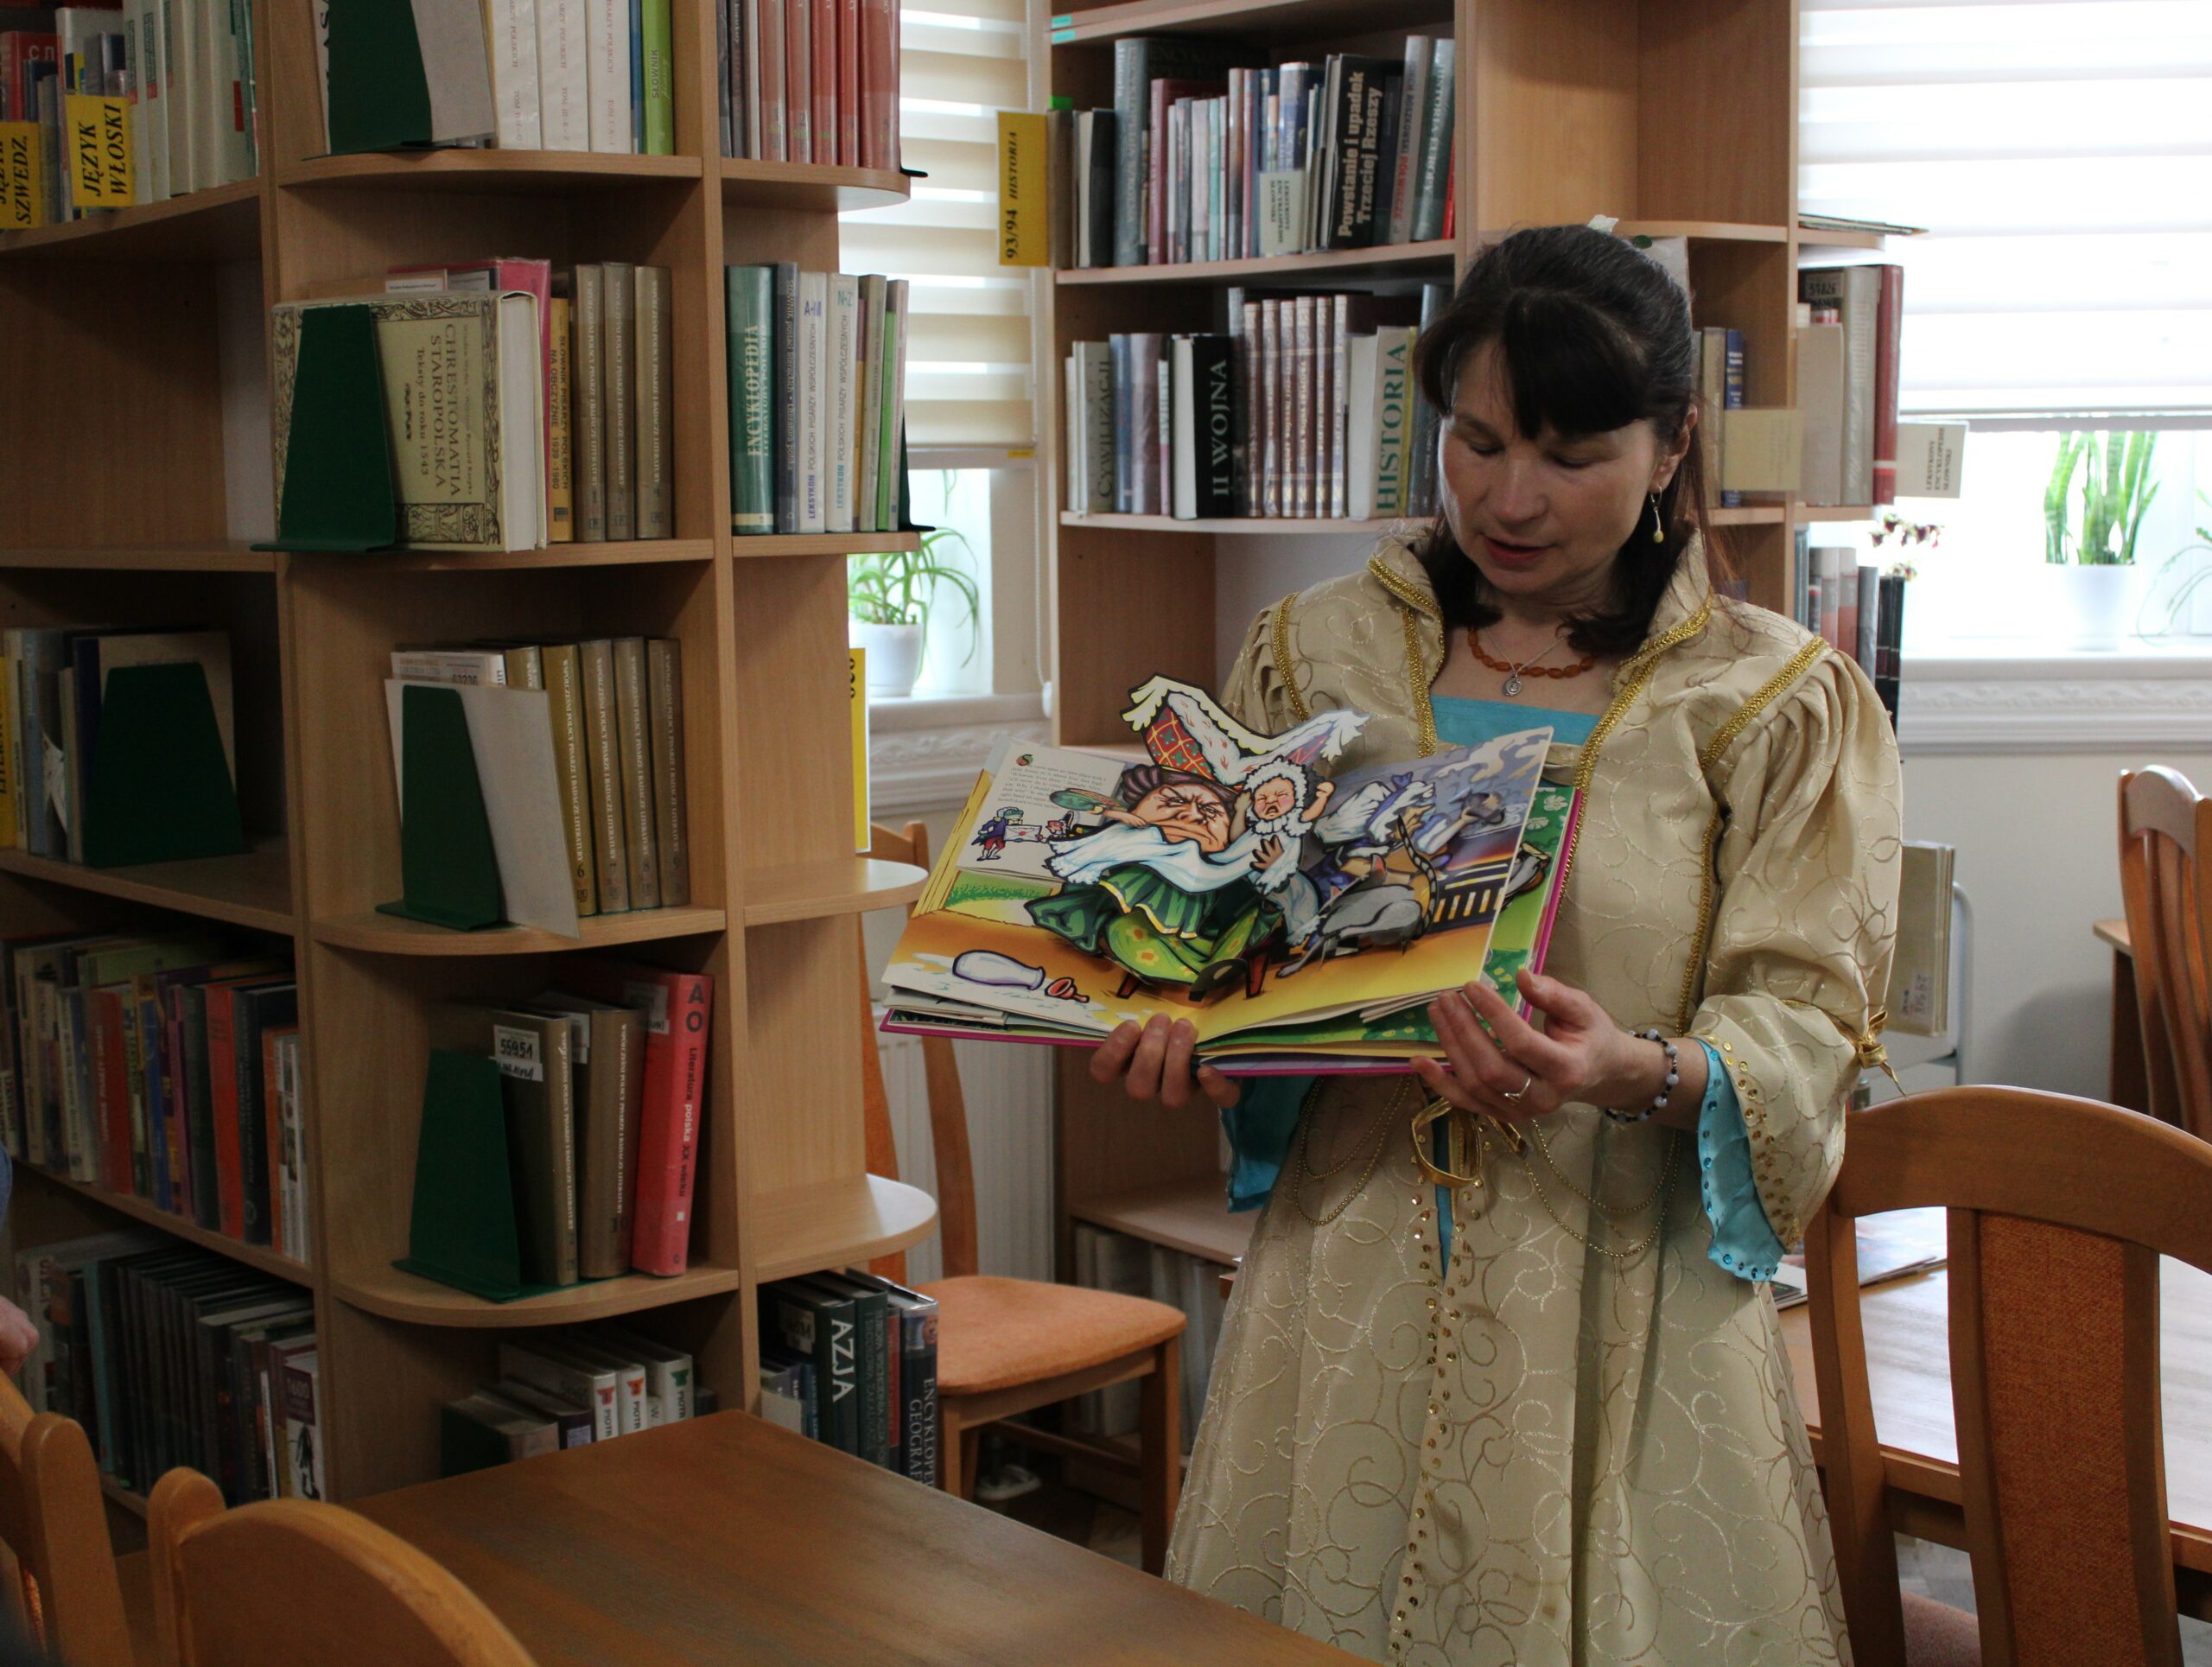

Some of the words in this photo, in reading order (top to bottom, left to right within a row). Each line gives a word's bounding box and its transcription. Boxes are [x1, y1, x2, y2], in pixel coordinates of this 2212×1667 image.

[650, 48, 660, 99] SŁOWNIK
[1347, 71, 1365, 137] upadek
[1362, 85, 1384, 152] Rzeszy
[1431, 66, 1446, 134] HISTORIA
[79, 123, 102, 198] JĘZYK
[104, 102, 129, 196] WŁOSKI
[1344, 136, 1360, 144] i
[11, 135, 31, 225] SZWEDZ.
[1008, 130, 1019, 200] HISTORIA
[1423, 137, 1440, 193] EUROPY
[1338, 148, 1359, 238] Powstanie
[1357, 151, 1380, 225] Trzeciej
[1005, 208, 1018, 259] 93/94
[786, 279, 795, 319] SŁOWNIK
[550, 349, 558, 366] NA
[785, 321, 795, 351] postaci
[416, 347, 426, 387] Teksty
[560, 335, 569, 384] SŁOWNIK
[786, 352, 795, 393] literackich
[418, 391, 427, 407] do
[430, 334, 447, 488] STAROPOLSKA
[444, 323, 461, 497] CHRESTOMATIA
[560, 387, 569, 433] PISARZY
[745, 324, 762, 456] ENCYKLOPEDIA
[839, 386, 848, 419] PISARZY
[419, 410, 428, 440] roku
[760, 385, 769, 457] LITERATURY
[786, 404, 795, 442] Literatura
[1097, 359, 1113, 499] CYWILIZACJI
[1210, 359, 1230, 468] WOJNA
[1376, 343, 1407, 511] HISTORIA
[420, 444, 429, 476] 1543
[551, 436, 560, 460] 1939
[561, 436, 569, 490] POLSKICH
[785, 444, 795, 471] polska
[836, 464, 845, 509] LEKSYKON
[1212, 474, 1230, 496] II
[563, 659, 572, 711] WSPÓŁCZEŚNI
[599, 710, 607, 740] POLSCY
[570, 780, 579, 815] BADACZE
[604, 779, 613, 811] BADACZE
[638, 775, 646, 810] BADACZE
[573, 817, 584, 862] LITERATURY
[607, 815, 617, 860] LITERATURY
[640, 811, 650, 856] LITERATURY
[672, 810, 681, 853] LITERATURY
[576, 862, 585, 879] 6
[688, 983, 705, 1005] A
[685, 1010, 703, 1033] O
[499, 1038, 533, 1059] 55951
[685, 1047, 698, 1101] Literatura
[682, 1104, 694, 1142] polska
[681, 1144, 691, 1161] XX
[678, 1164, 689, 1197] wieku
[831, 1319, 855, 1403] AZJA
[604, 1409, 613, 1437] PIOTR
[677, 1390, 686, 1419] PIOTR
